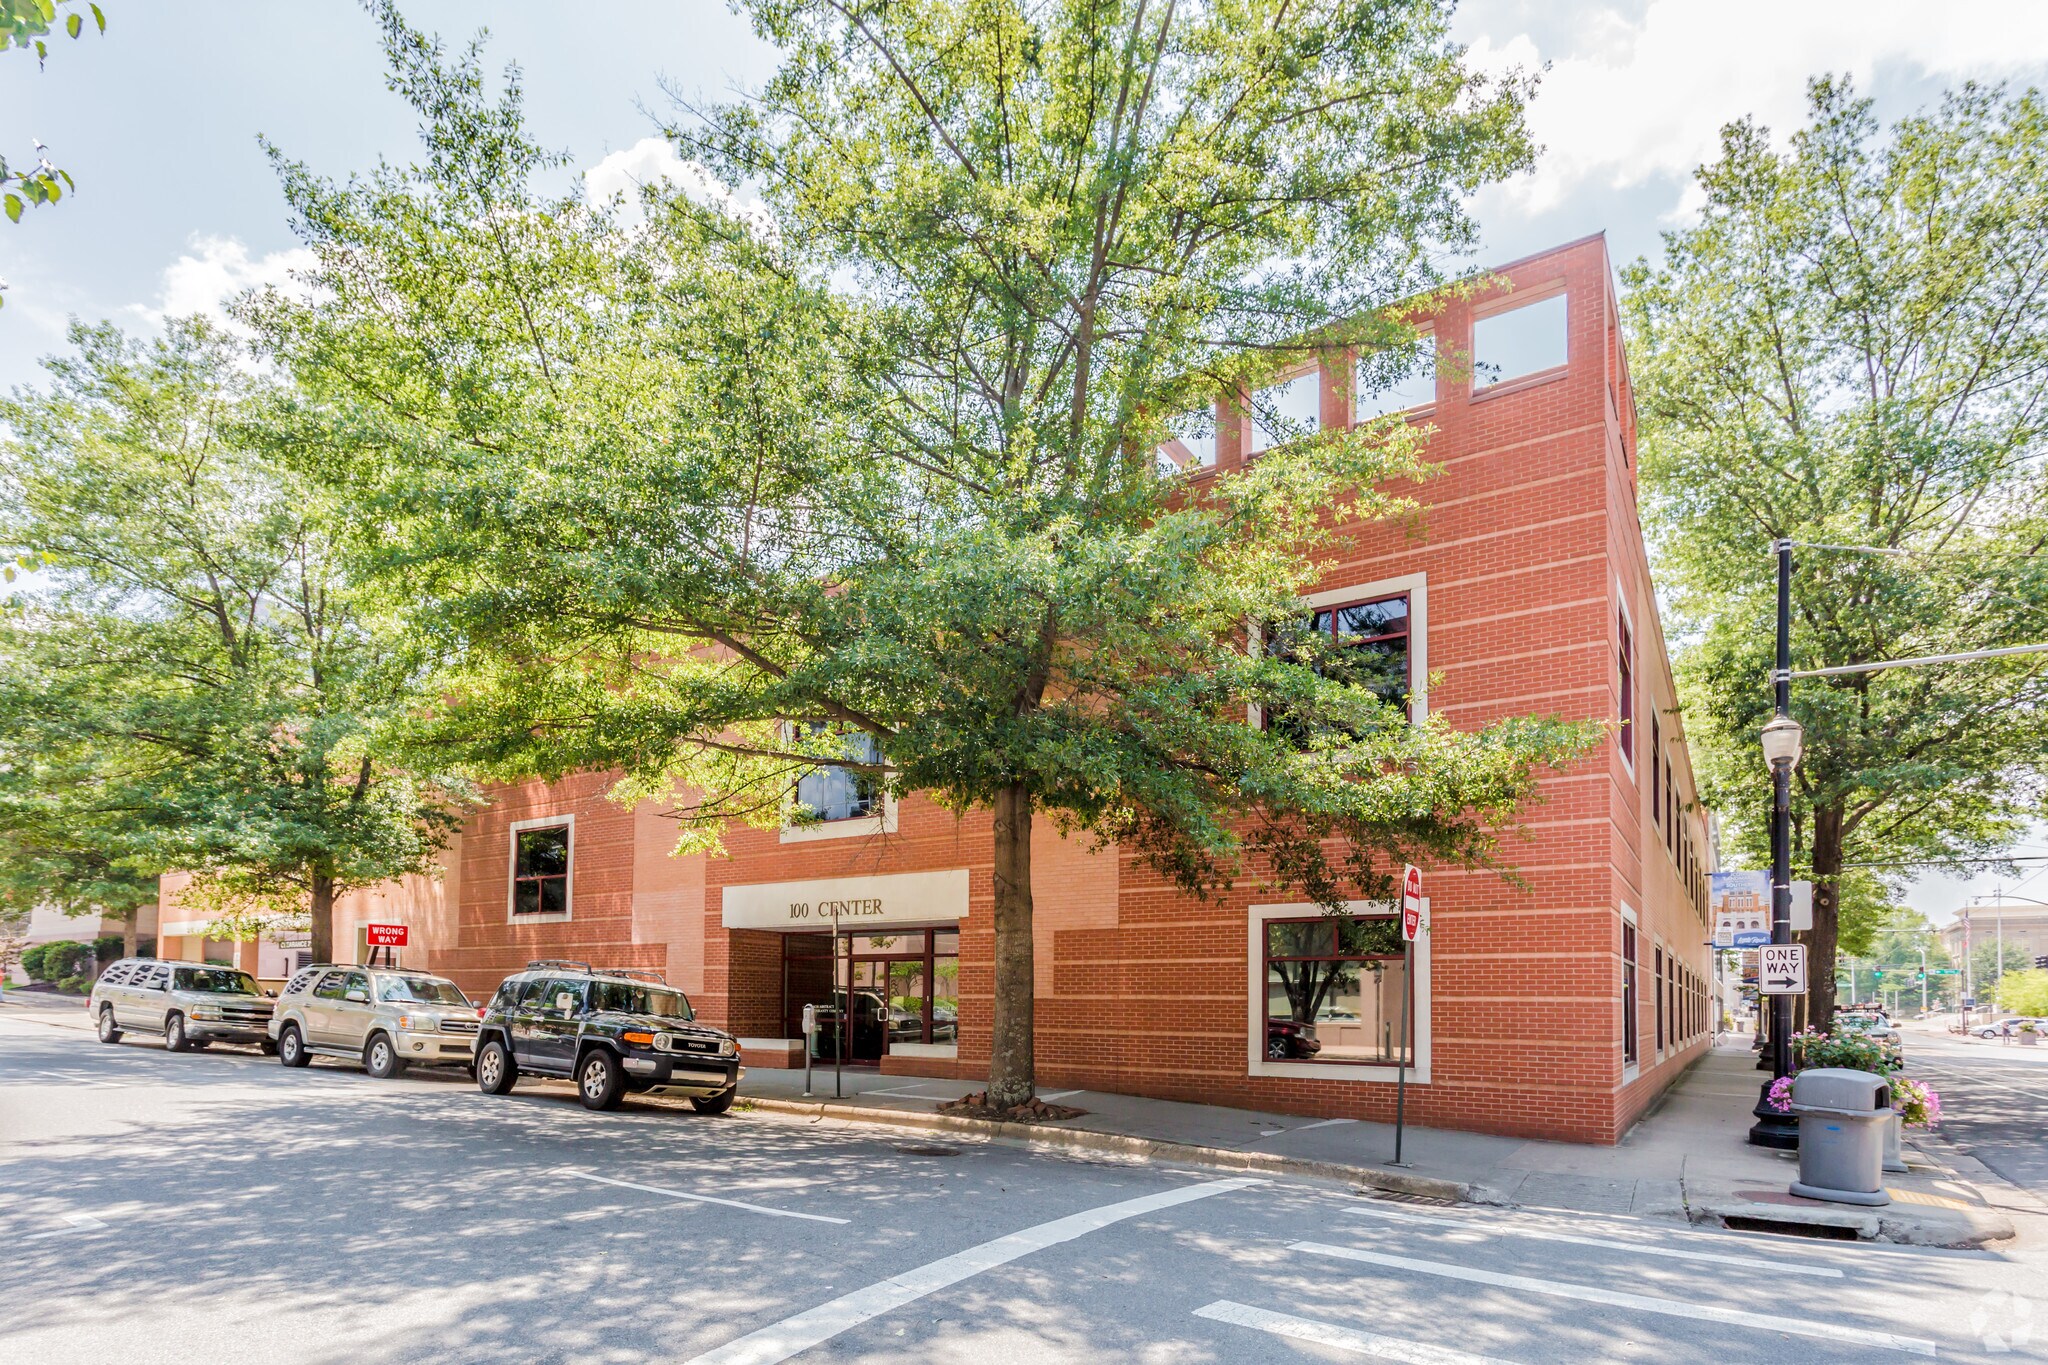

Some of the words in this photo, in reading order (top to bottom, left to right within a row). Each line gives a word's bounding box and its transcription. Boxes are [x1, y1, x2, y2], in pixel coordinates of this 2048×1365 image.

[1408, 880, 1413, 892] DO
[790, 903, 809, 919] 100
[818, 899, 884, 917] CENTER
[1407, 913, 1416, 926] ENTER
[372, 926, 405, 936] WRONG
[378, 935, 398, 944] WAY
[1766, 949, 1799, 961] ONE
[1766, 962, 1799, 974] WAY
